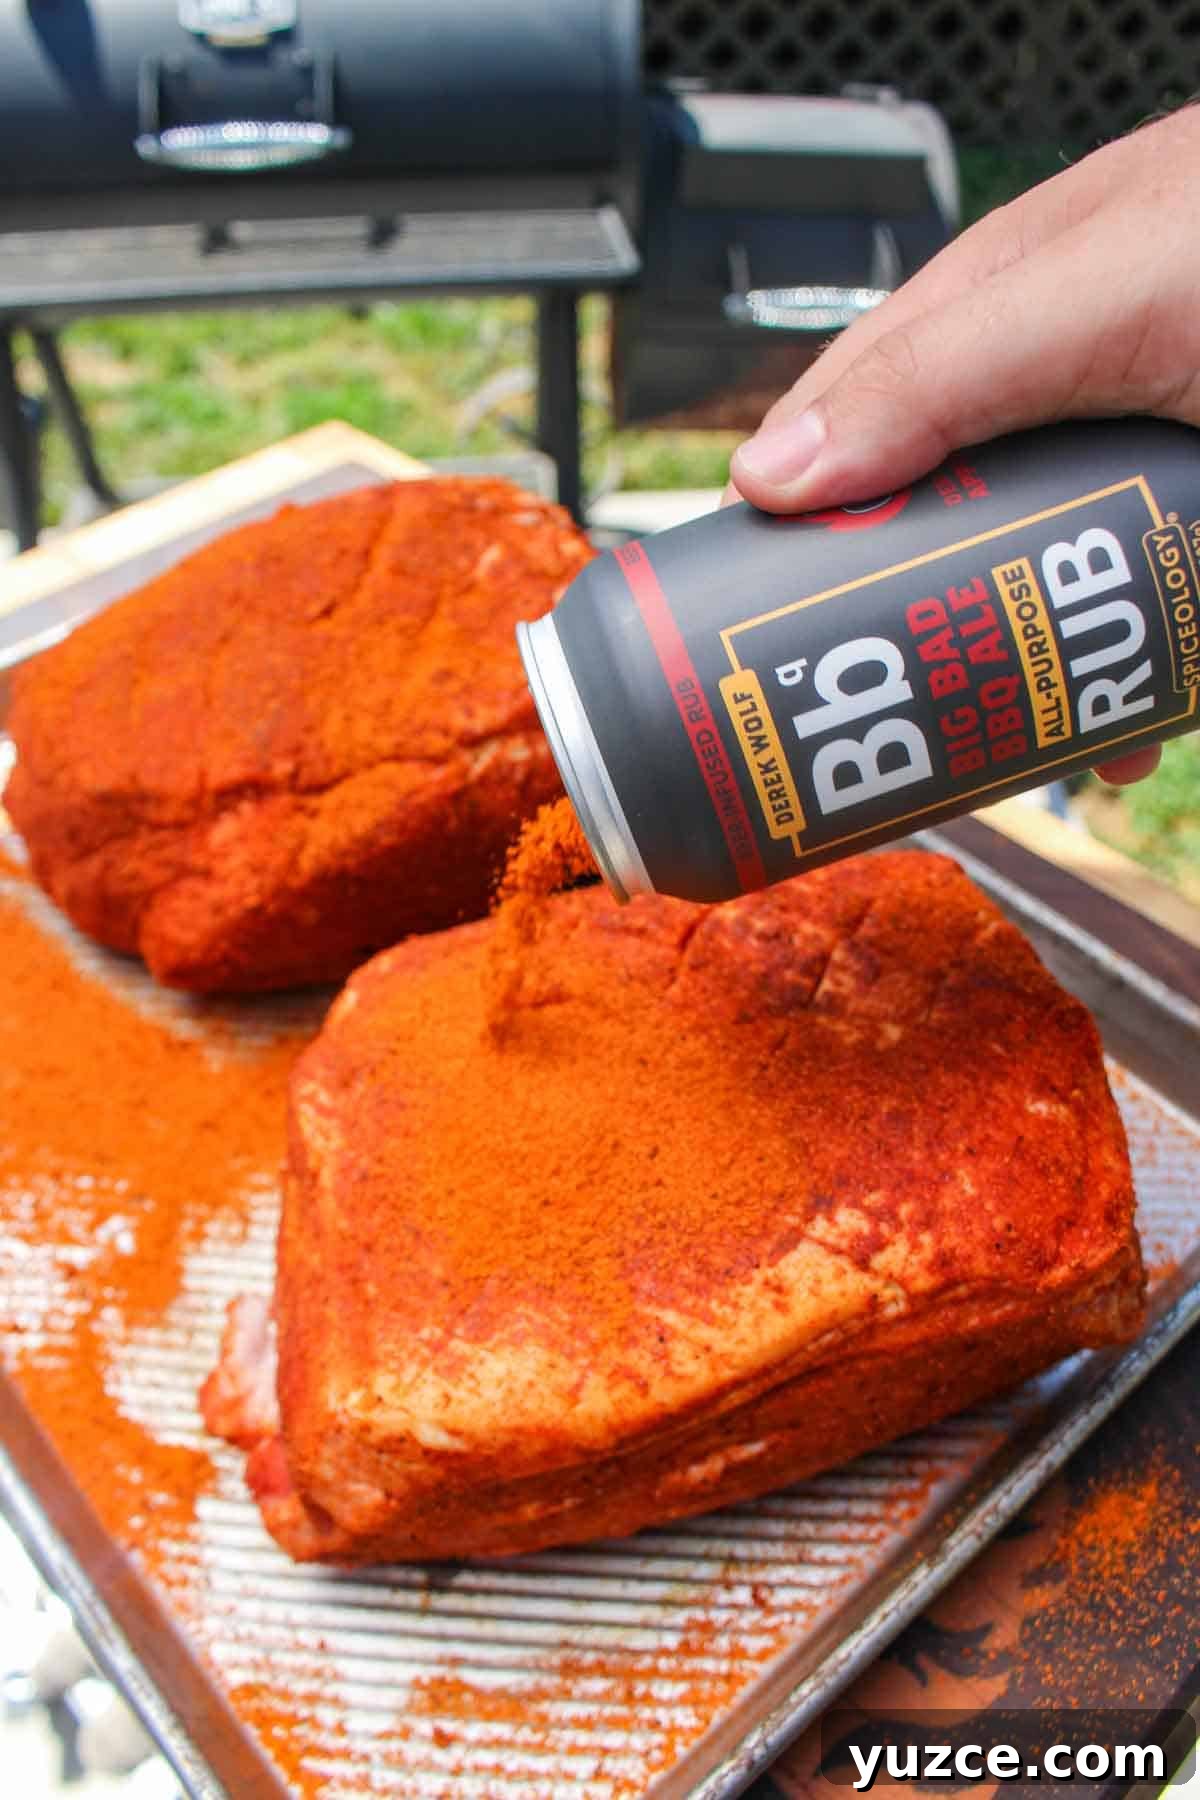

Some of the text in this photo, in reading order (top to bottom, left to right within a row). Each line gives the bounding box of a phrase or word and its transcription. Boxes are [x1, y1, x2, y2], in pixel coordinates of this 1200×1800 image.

[906, 596, 986, 779] BIG BAD
[946, 577, 1028, 764] BBQ ALE
[1002, 564, 1066, 739] ALL-PURPOSE
[1041, 527, 1155, 735] RUB
[1152, 533, 1200, 688] SPICEOLOGY
[676, 676, 706, 723] RUB
[733, 691, 796, 828] DEREK WOLF
[793, 636, 933, 816] Bb
